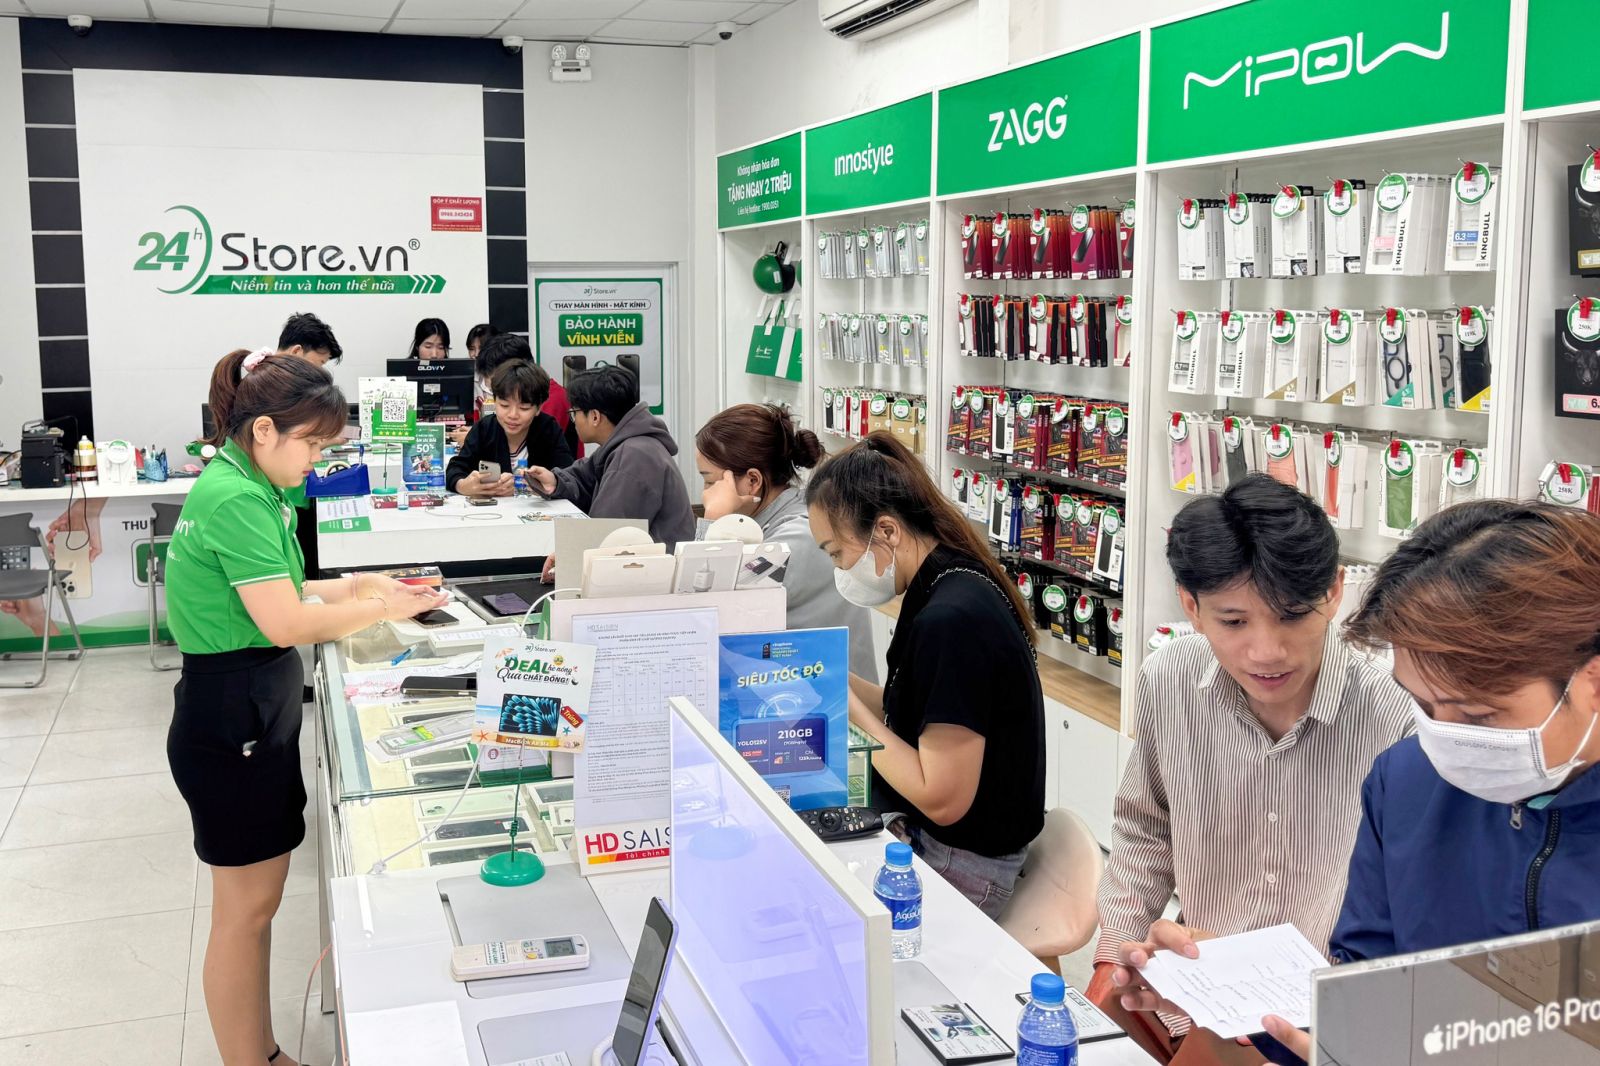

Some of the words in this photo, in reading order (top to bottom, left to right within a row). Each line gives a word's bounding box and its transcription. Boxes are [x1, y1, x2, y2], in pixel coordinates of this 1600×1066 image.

[988, 94, 1068, 152] ZAGG
[728, 183, 745, 205] TẶNG
[746, 179, 764, 199] NGAY
[765, 178, 770, 195] 2
[770, 170, 792, 195] TRIỆU
[1395, 219, 1406, 264] KINGBULL
[1455, 231, 1466, 241] 6.3
[1480, 211, 1491, 260] KINGBULL
[231, 277, 269, 292] Niềm
[273, 279, 292, 291] tin
[297, 279, 312, 291] và
[316, 279, 341, 291] hơn
[346, 278, 370, 291] thế
[372, 278, 395, 291] nữa
[591, 301, 608, 309] HÌNH
[629, 301, 646, 309] KÍNH
[565, 315, 594, 330] BẢO
[598, 316, 636, 329] HÀNH
[567, 332, 600, 345] VĨNH
[603, 329, 635, 344] VIỄN
[122, 520, 148, 531] THU
[504, 655, 550, 674] DEAL
[523, 672, 543, 681] CHẤT
[543, 674, 569, 684] ĐỐNG!
[737, 671, 769, 688] SIÊU
[772, 664, 800, 682] TỐC
[803, 660, 824, 678] ĐỘ
[778, 728, 813, 739] 210GB
[584, 832, 619, 854] HD
[625, 852, 638, 860] Tài
[642, 849, 665, 858] chính
[1445, 1013, 1532, 1051] iPhone
[1534, 1002, 1561, 1032] 16
[1564, 998, 1600, 1026] Pro
